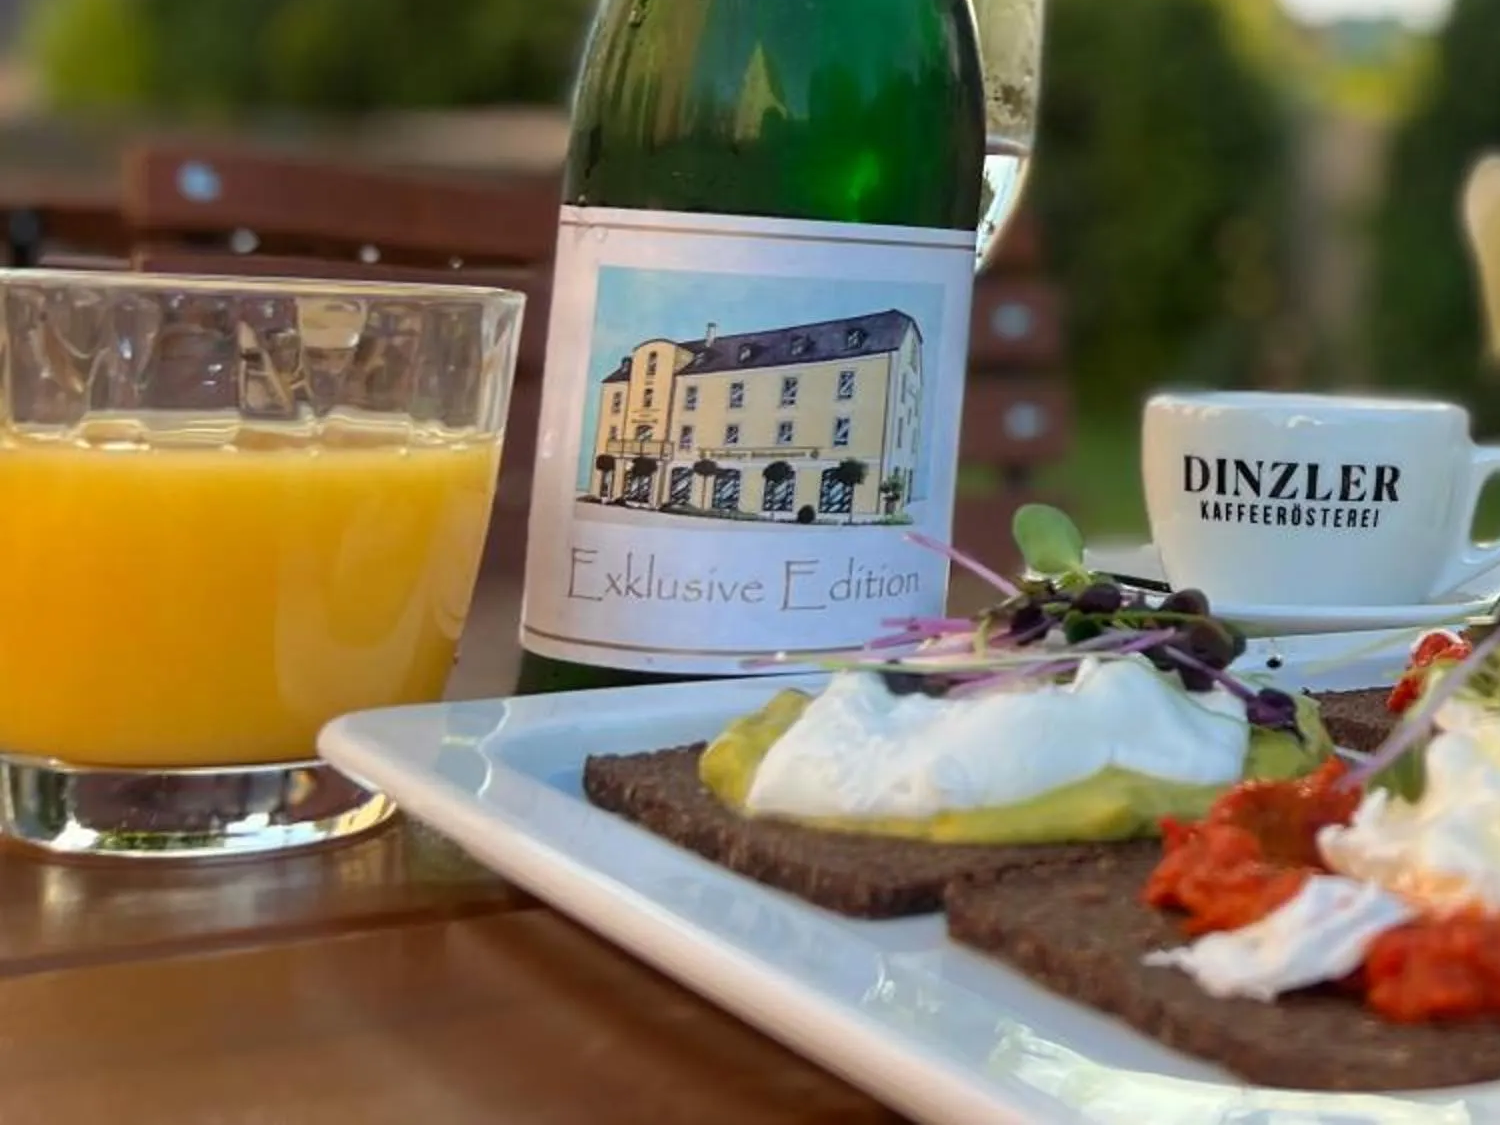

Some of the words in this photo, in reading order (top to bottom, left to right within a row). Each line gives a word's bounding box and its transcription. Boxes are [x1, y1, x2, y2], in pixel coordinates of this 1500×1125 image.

[1183, 454, 1401, 503] DINZLER
[1200, 500, 1380, 528] KAFFEERÖSTEREI
[566, 546, 765, 604] Exklusive
[779, 556, 920, 613] Edition
